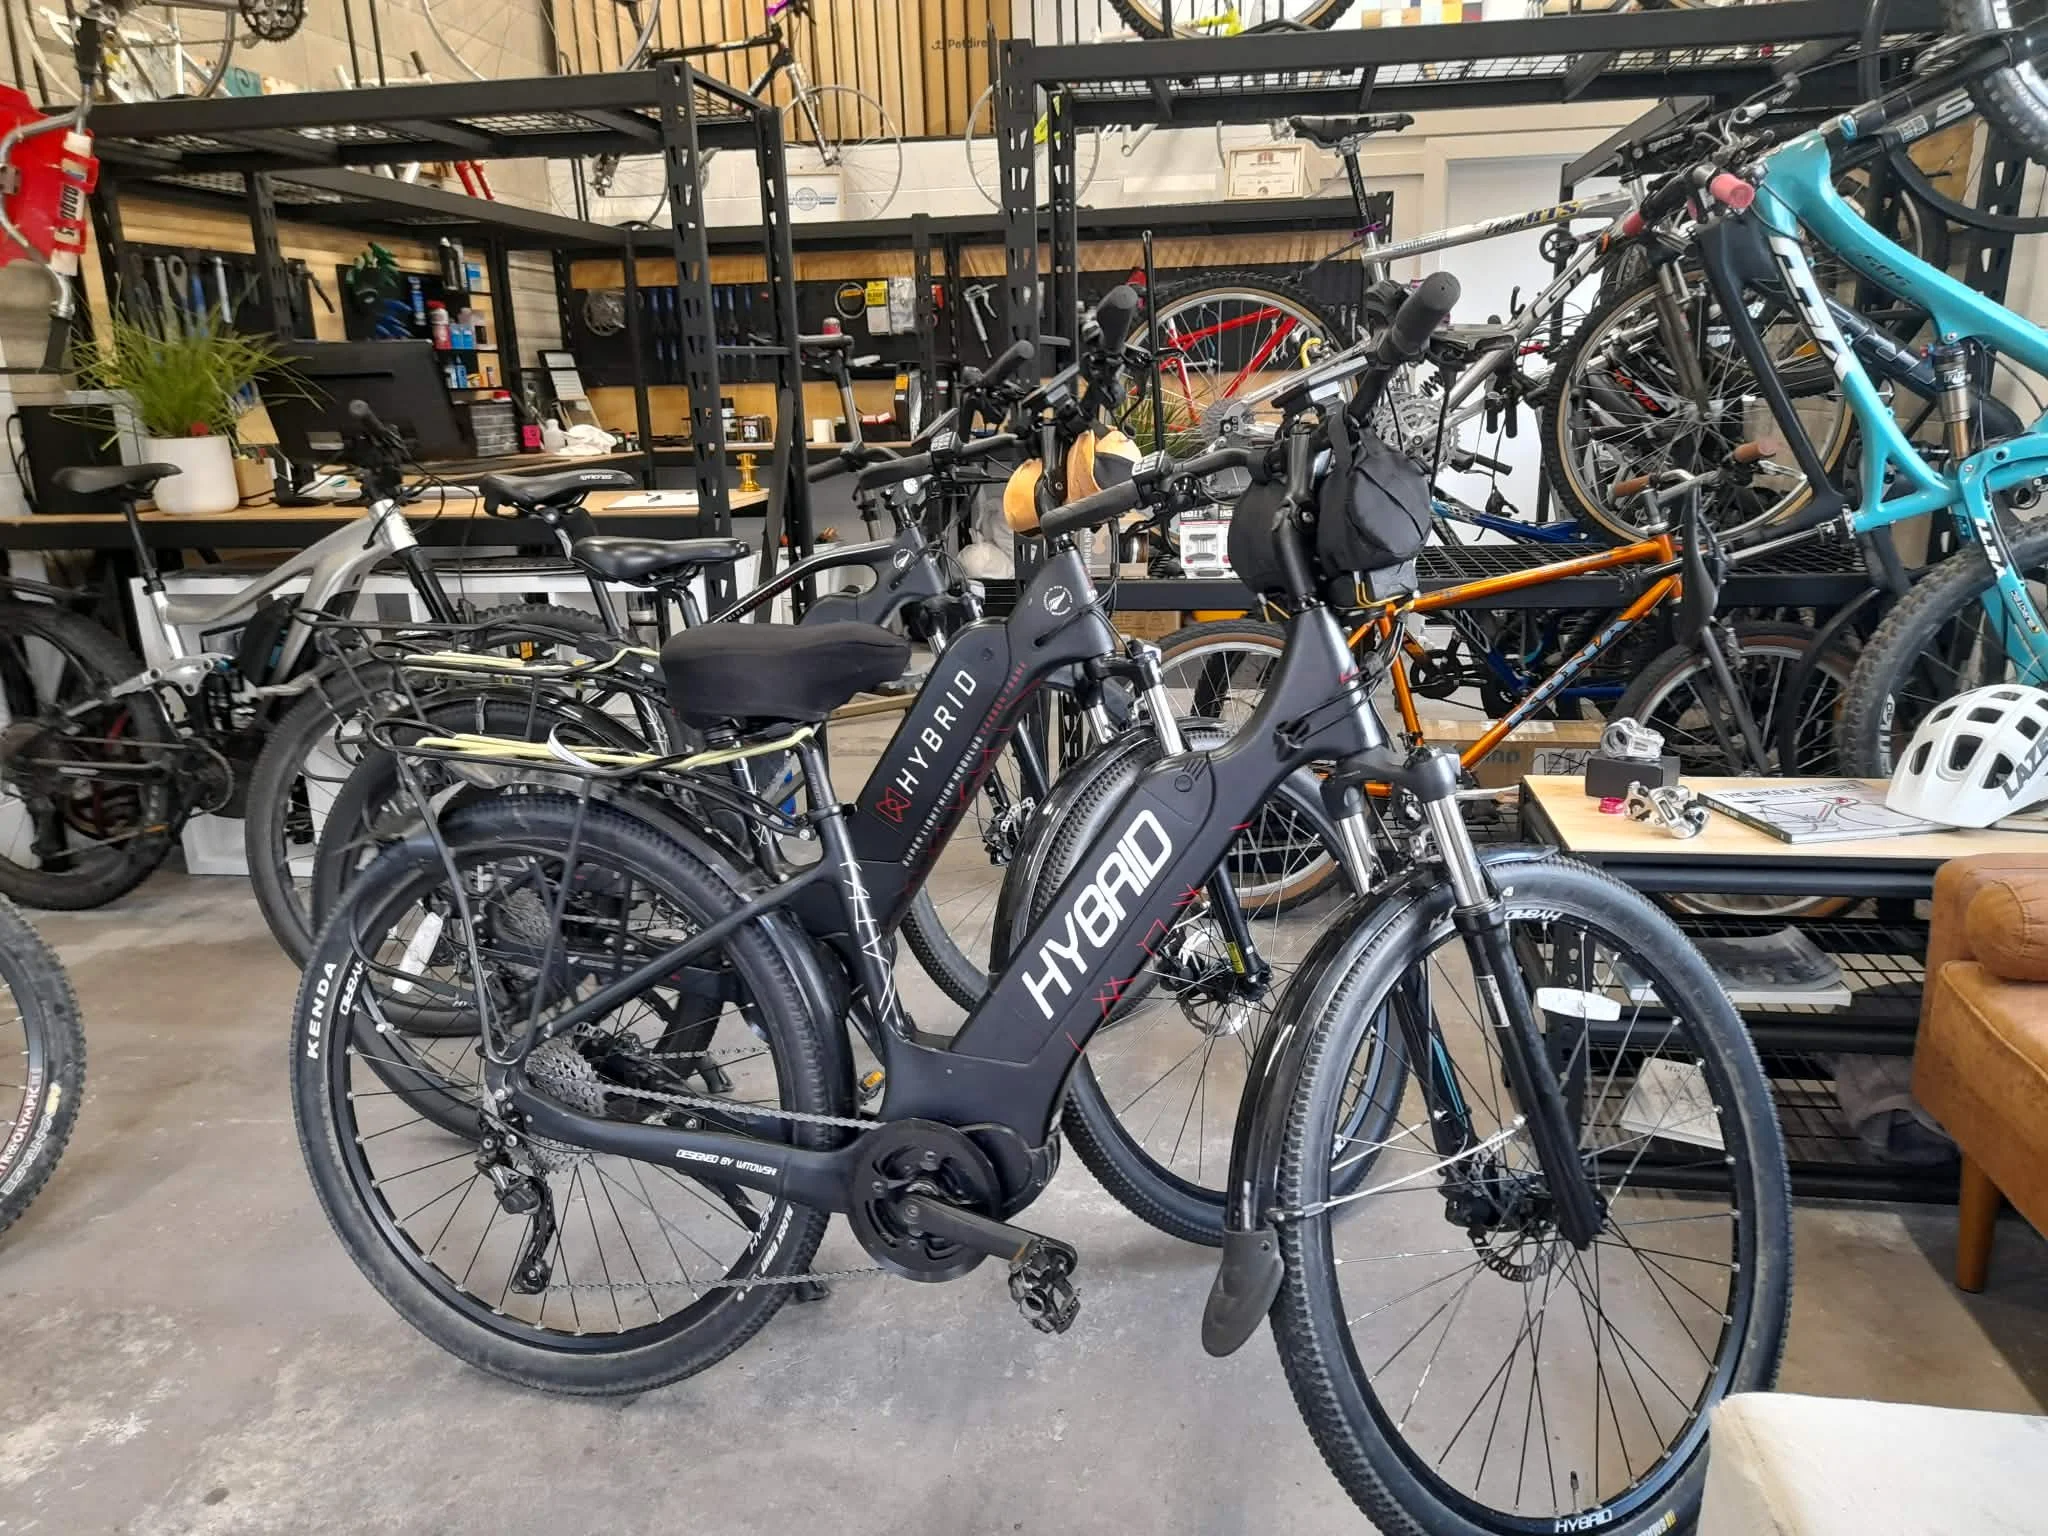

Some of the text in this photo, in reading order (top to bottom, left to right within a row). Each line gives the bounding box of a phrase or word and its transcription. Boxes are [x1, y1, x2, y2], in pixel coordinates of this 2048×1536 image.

[896, 669, 978, 796] HYBRID
[1021, 809, 1173, 1020] HYBRID
[307, 963, 337, 1060] KENDA
[675, 1148, 720, 1164] DESIGNED
[719, 1156, 735, 1167] BY
[760, 1204, 794, 1275] BLOCK EIGHT
[1554, 1508, 1613, 1534] HYBRID
